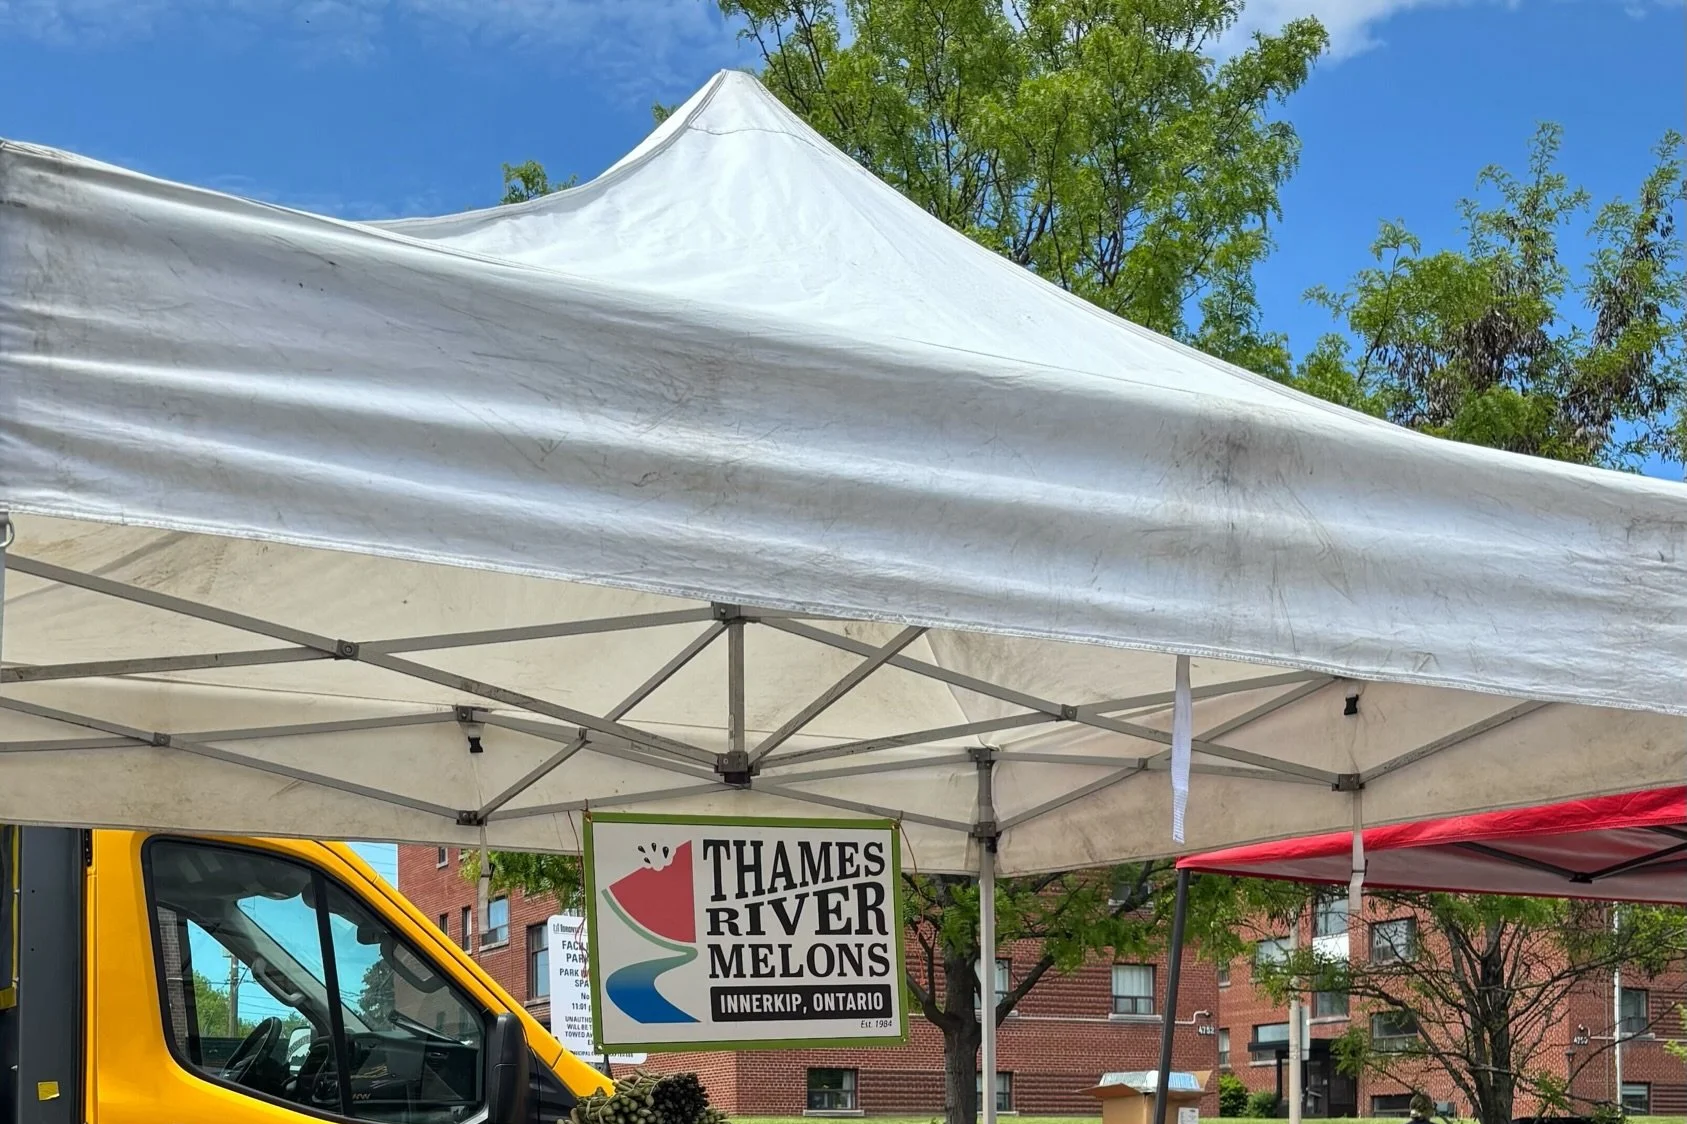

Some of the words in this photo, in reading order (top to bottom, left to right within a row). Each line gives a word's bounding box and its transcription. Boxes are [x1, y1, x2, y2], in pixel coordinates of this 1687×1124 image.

[703, 839, 885, 902] THAMES
[706, 882, 889, 936] RIVER
[707, 943, 890, 978] MELONS
[560, 968, 579, 977] PARK
[572, 1002, 587, 1011] 11:01
[720, 993, 808, 1014] INNERKIP,
[813, 992, 884, 1011] ONTARIO
[875, 1019, 892, 1028] 1984
